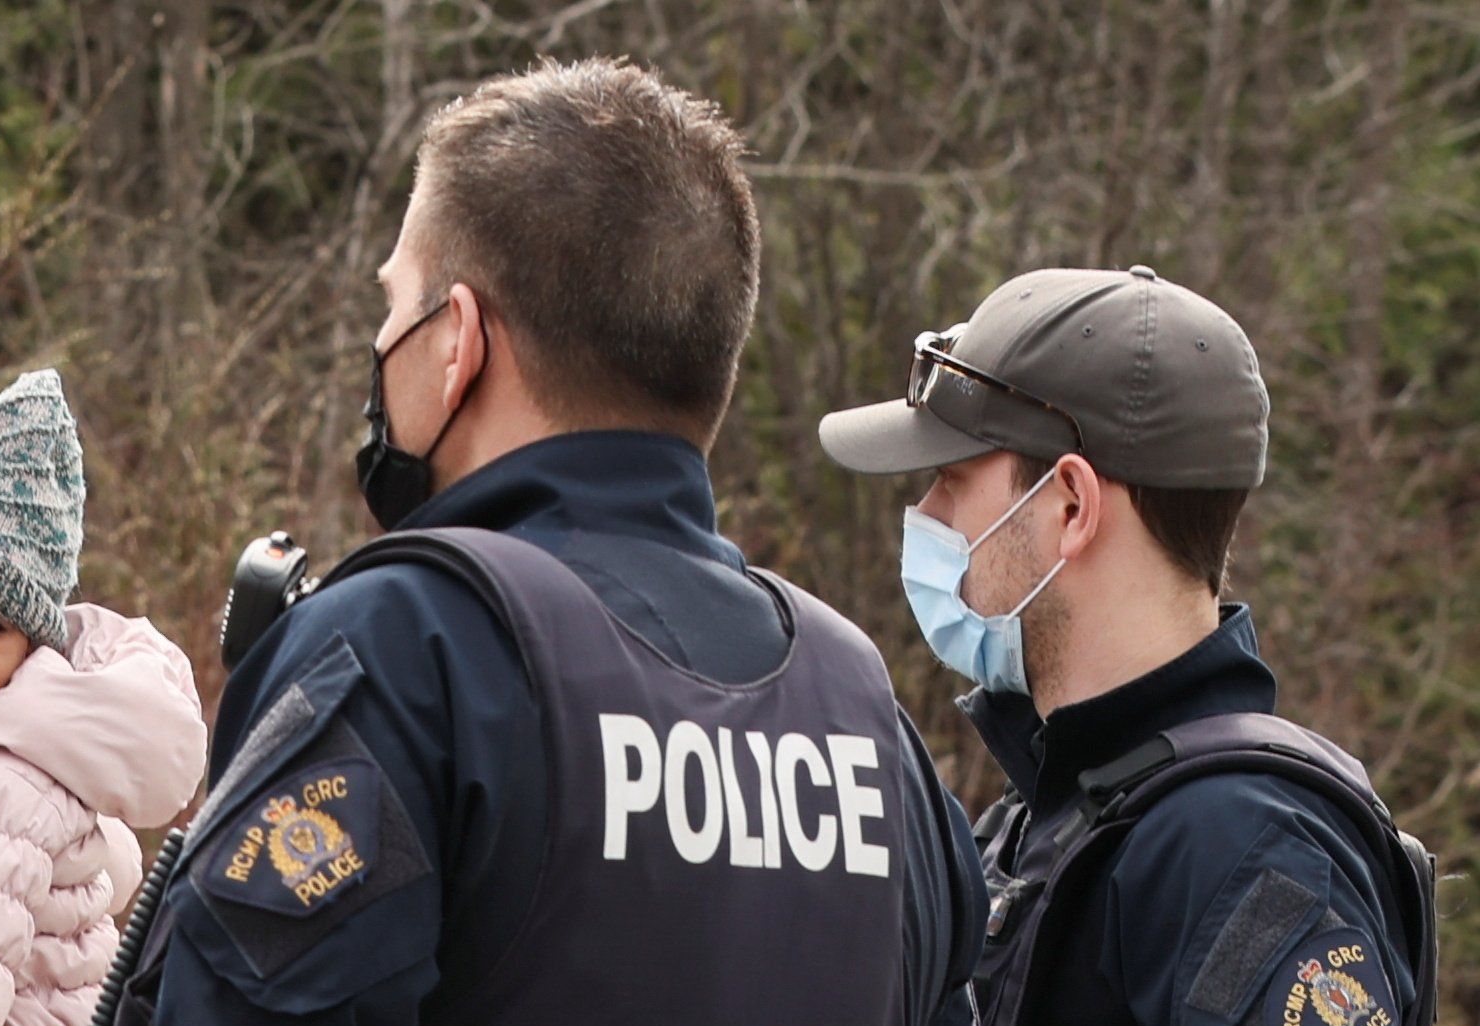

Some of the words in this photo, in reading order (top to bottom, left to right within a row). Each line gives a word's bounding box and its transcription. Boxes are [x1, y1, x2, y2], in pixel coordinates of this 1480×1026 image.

[303, 775, 348, 807] GRC
[598, 713, 889, 878] POLICE
[225, 826, 265, 883] RCMP
[294, 849, 365, 907] POLICE
[1327, 944, 1364, 968] GRC
